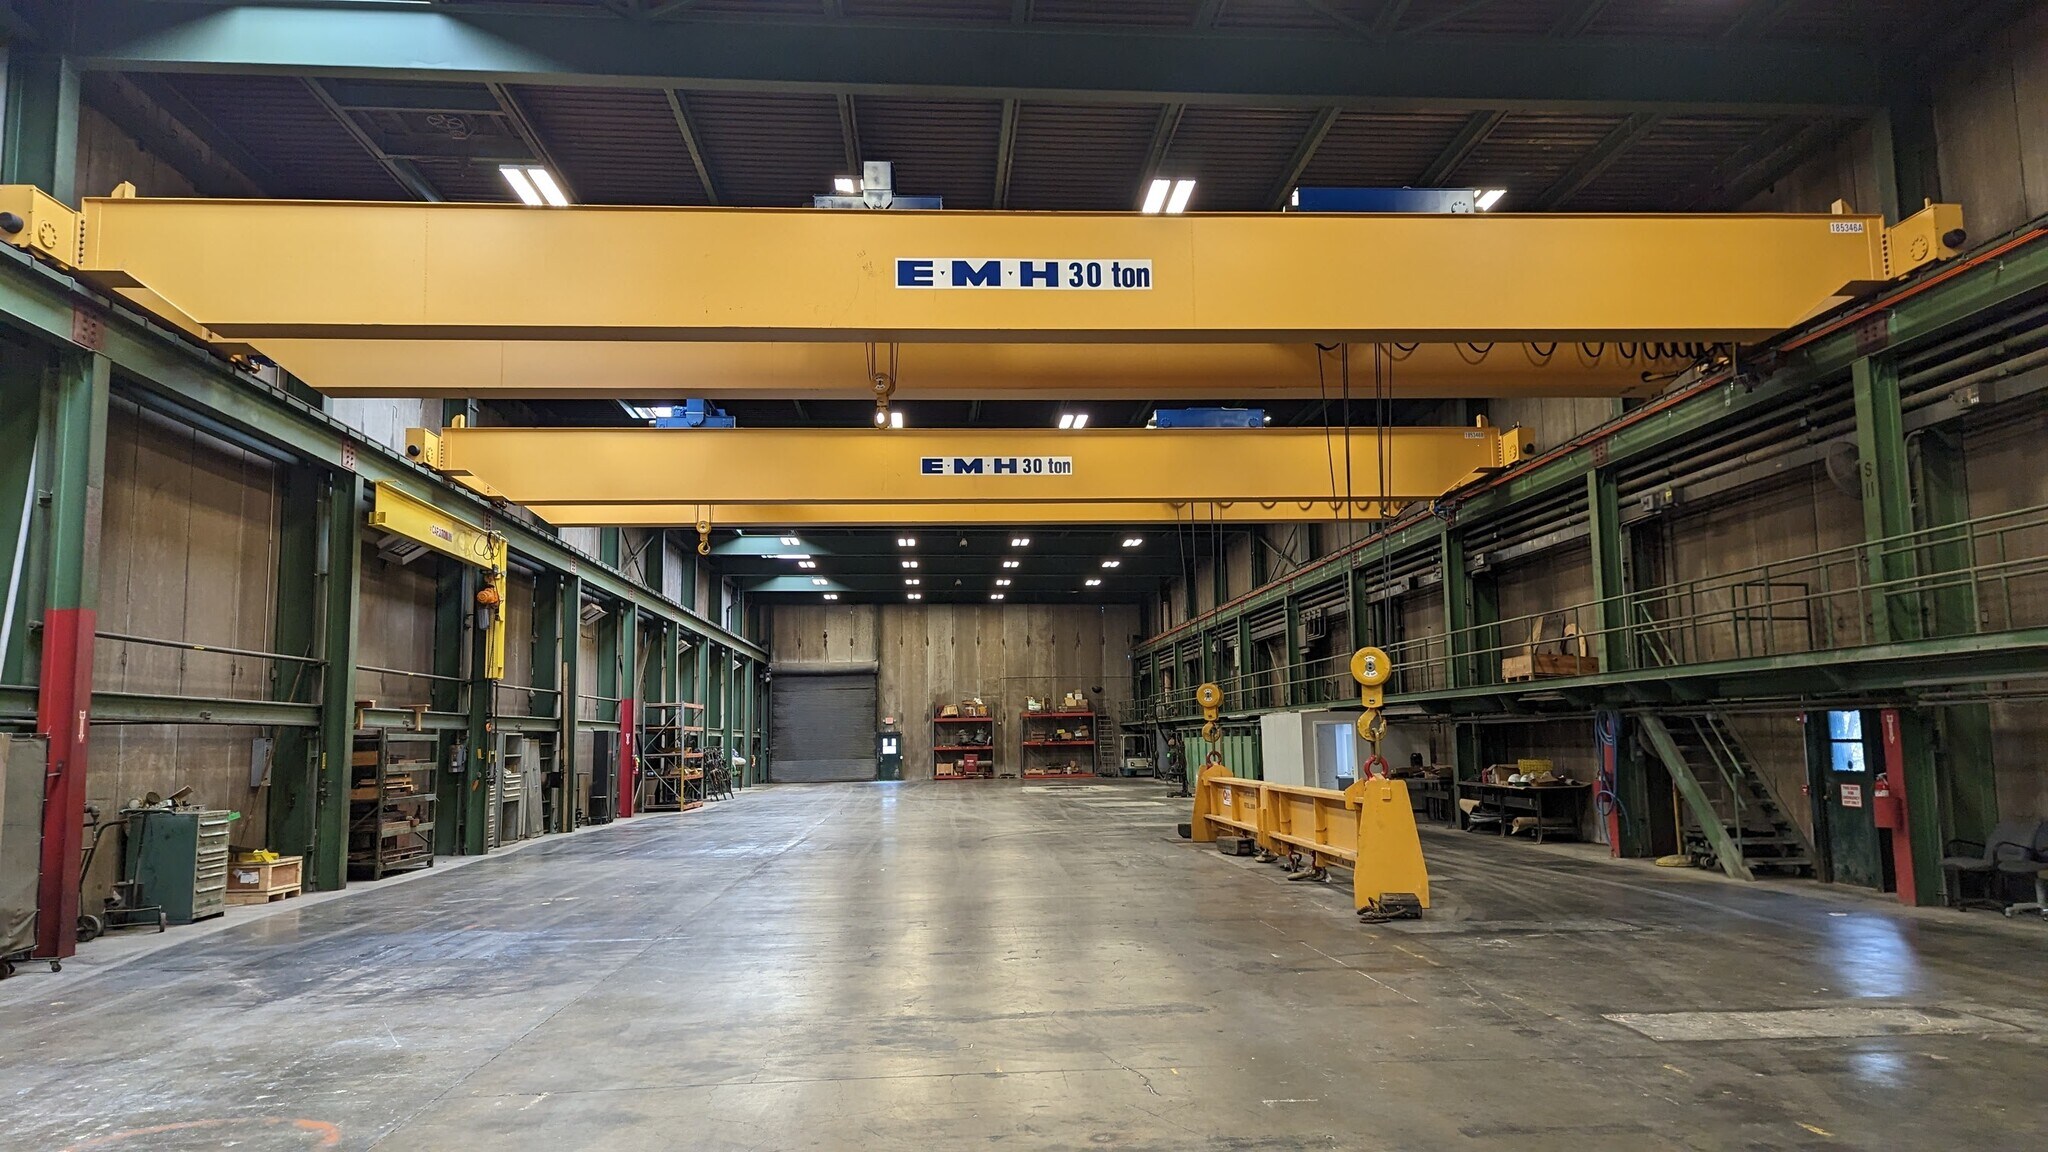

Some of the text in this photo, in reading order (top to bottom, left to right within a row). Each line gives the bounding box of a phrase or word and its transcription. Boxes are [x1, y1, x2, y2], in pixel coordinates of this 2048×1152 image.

[1831, 223, 1863, 232] 185346A
[1068, 262, 1101, 287] 30
[1111, 262, 1150, 288] ton
[1022, 458, 1042, 474] 30
[1048, 458, 1070, 474] ton
[1864, 461, 1872, 478] S
